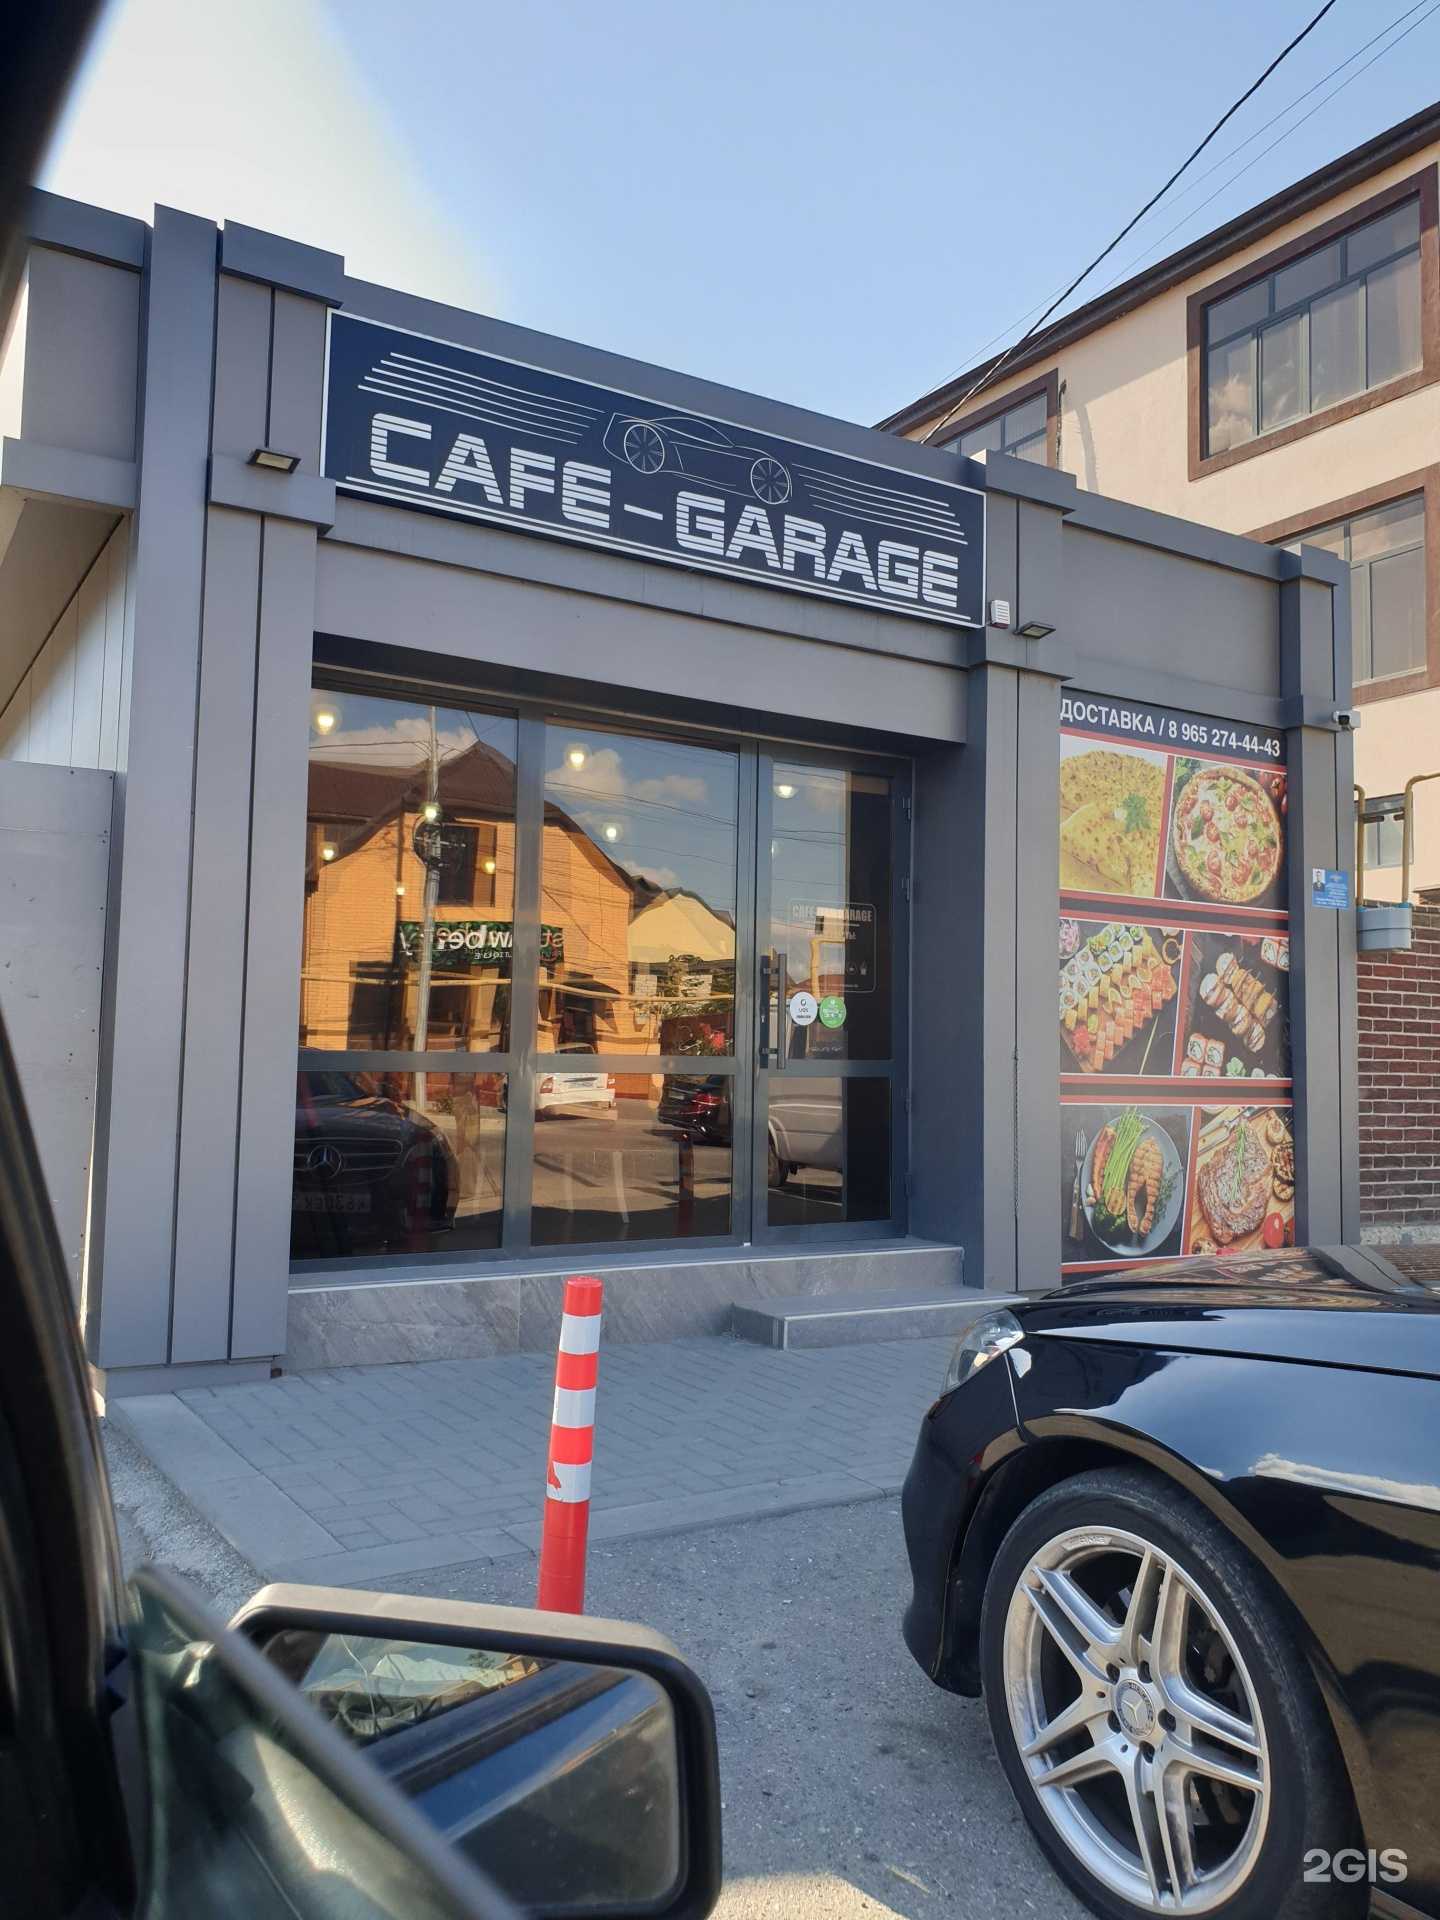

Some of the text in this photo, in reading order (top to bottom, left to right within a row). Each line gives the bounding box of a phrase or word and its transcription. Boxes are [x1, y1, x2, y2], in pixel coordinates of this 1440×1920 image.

[370, 413, 612, 529] CAFE
[676, 490, 959, 608] GARAGE
[1059, 698, 1155, 735] ДОСТАВКА
[1168, 720, 1177, 738] 8
[1181, 724, 1208, 744] 965
[1212, 729, 1280, 757] 274-44-43
